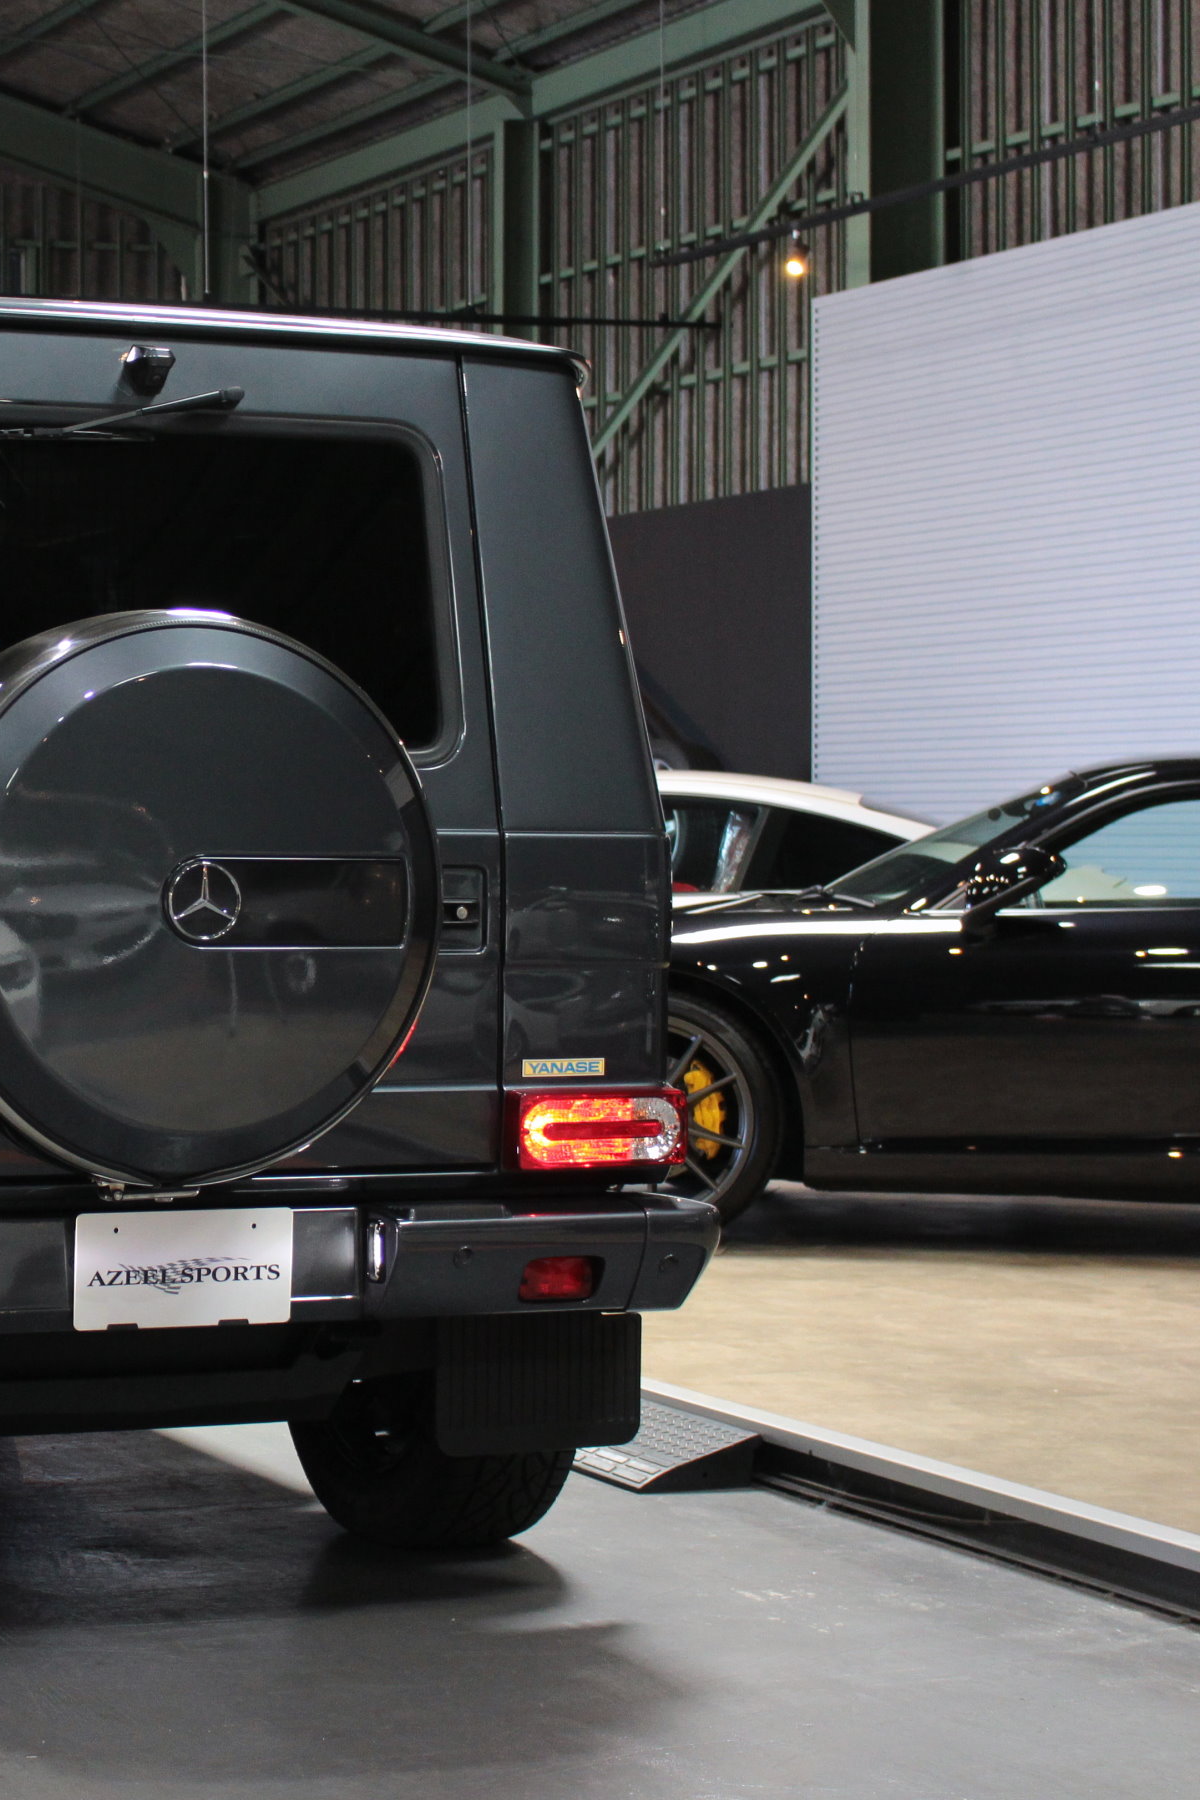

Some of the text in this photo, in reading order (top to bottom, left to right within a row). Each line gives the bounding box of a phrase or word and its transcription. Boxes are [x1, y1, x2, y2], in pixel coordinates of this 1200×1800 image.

[528, 1061, 601, 1074] YANASE
[87, 1264, 280, 1287] AZEEL SPORTS
